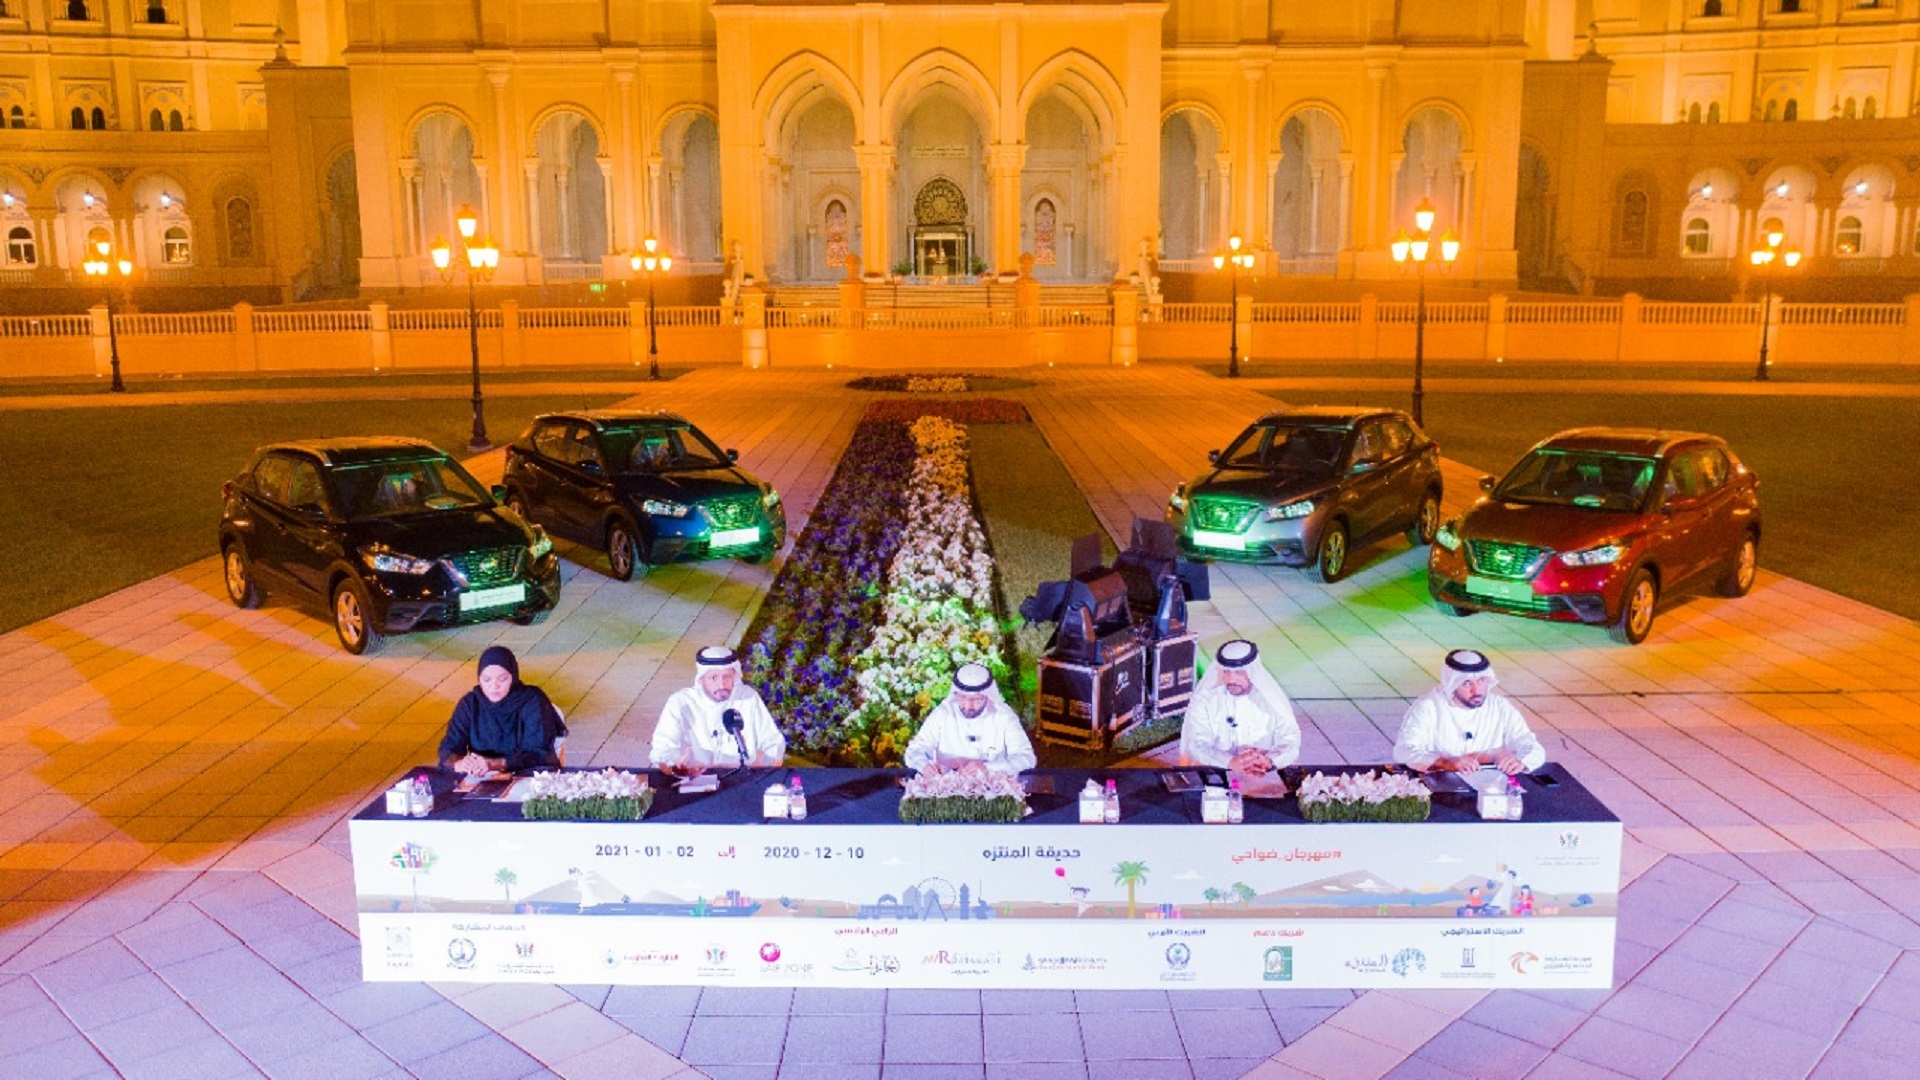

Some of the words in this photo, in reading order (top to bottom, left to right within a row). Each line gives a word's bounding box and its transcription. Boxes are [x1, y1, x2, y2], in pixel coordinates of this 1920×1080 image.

[595, 845, 628, 856] 2021
[644, 845, 662, 857] 01
[676, 845, 695, 857] 02
[764, 846, 799, 858] 2020
[815, 846, 832, 859] 12
[847, 846, 865, 859] 10
[982, 845, 1030, 862] المنتزه
[1035, 846, 1081, 862] حديقة
